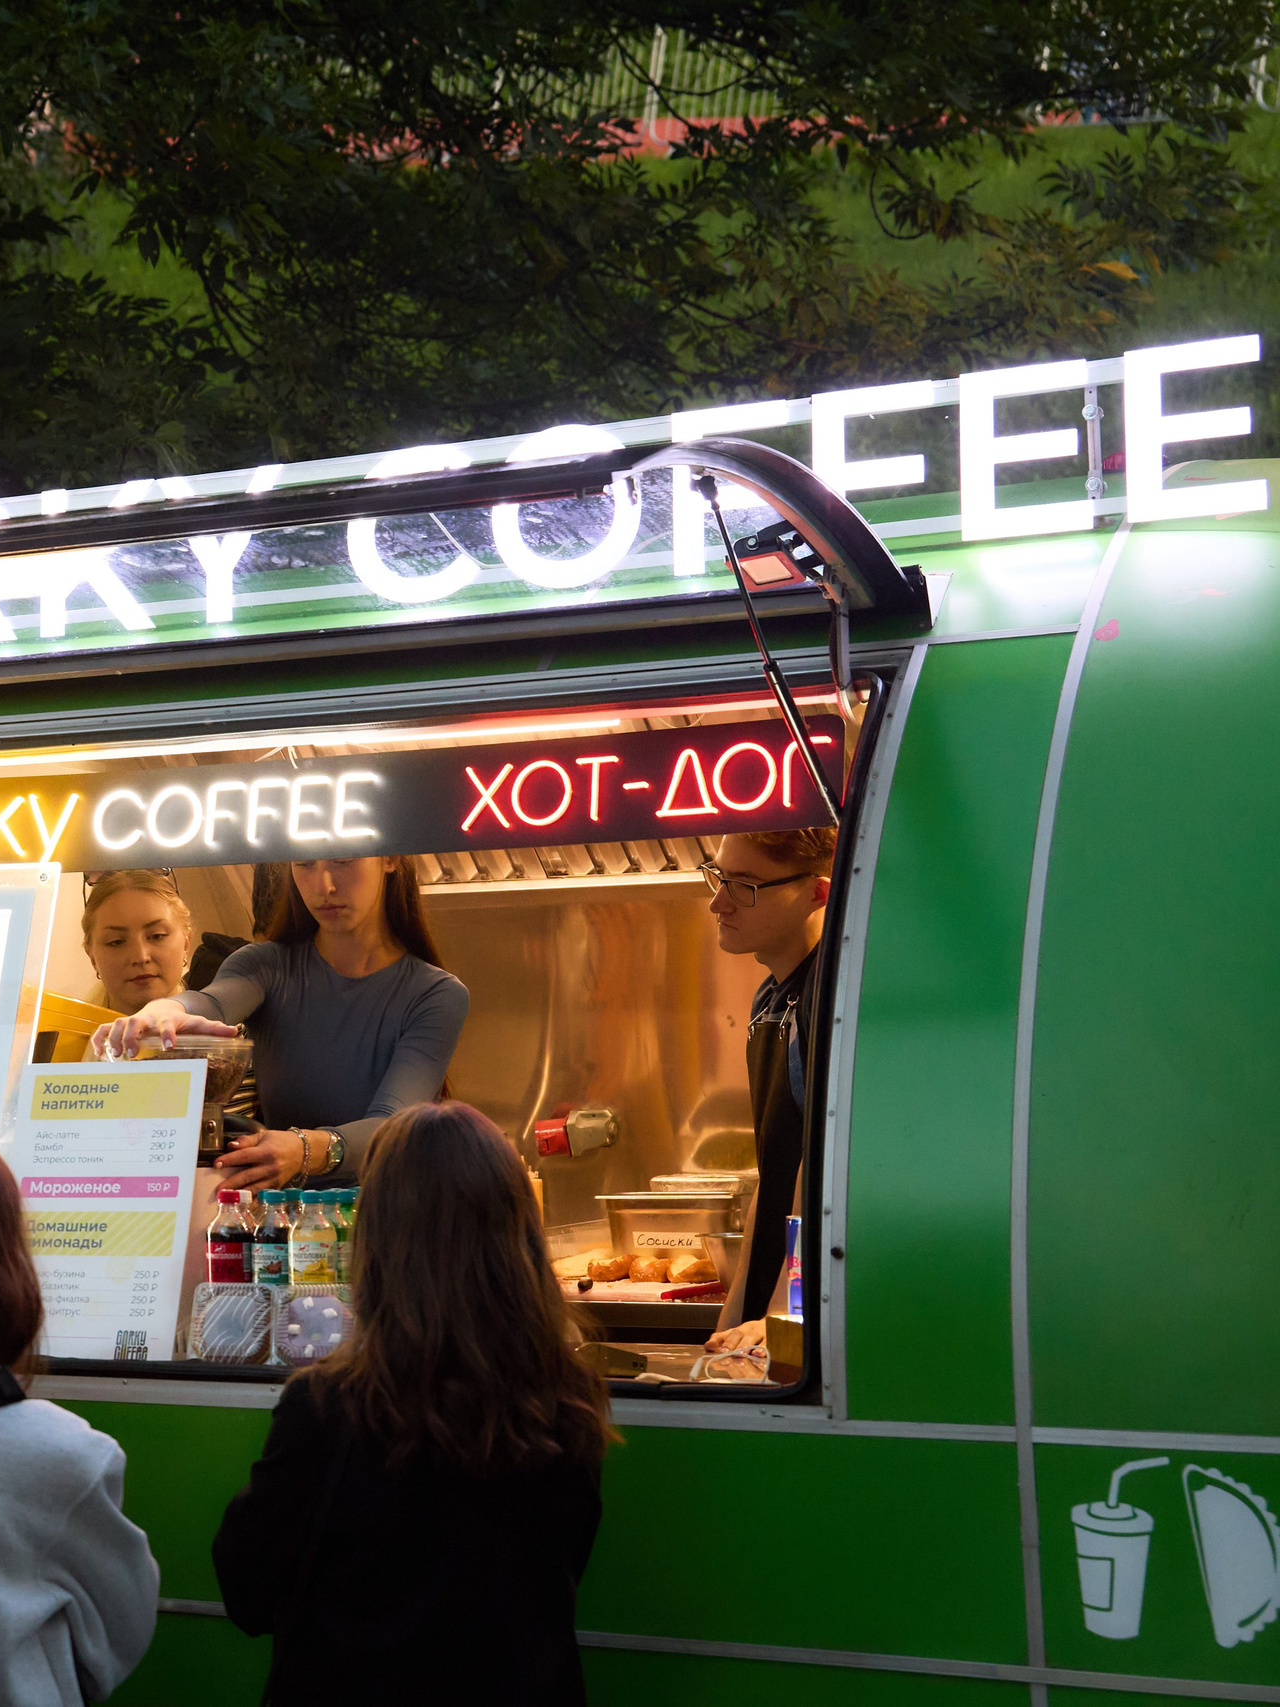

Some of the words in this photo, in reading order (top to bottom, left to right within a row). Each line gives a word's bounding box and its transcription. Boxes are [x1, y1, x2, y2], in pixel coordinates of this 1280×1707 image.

[347, 334, 1269, 604] COFFEE
[461, 735, 832, 831] ХОТ-ДОГ
[92, 772, 382, 851] COFFEE
[43, 1082, 120, 1095] Холодные
[41, 1099, 105, 1110] напитки
[36, 1131, 80, 1140] Айс-латте
[151, 1130, 168, 1138] 290
[34, 1143, 64, 1151] Бамбл
[150, 1142, 166, 1150] 290
[32, 1155, 76, 1165] Эспрессо
[148, 1154, 165, 1163] 290
[29, 1181, 121, 1196] Мороженое
[147, 1182, 162, 1192] 150
[27, 1220, 108, 1234] Домашние
[637, 1234, 693, 1247] Сосиски
[37, 1270, 86, 1280] ас-бузина
[134, 1271, 150, 1279] 250
[40, 1282, 80, 1291] -базилик
[132, 1283, 148, 1291] 250
[42, 1295, 90, 1304] ка-фиалка
[130, 1296, 147, 1304] 250
[46, 1307, 82, 1317] -цитрус
[129, 1308, 146, 1317] 250
